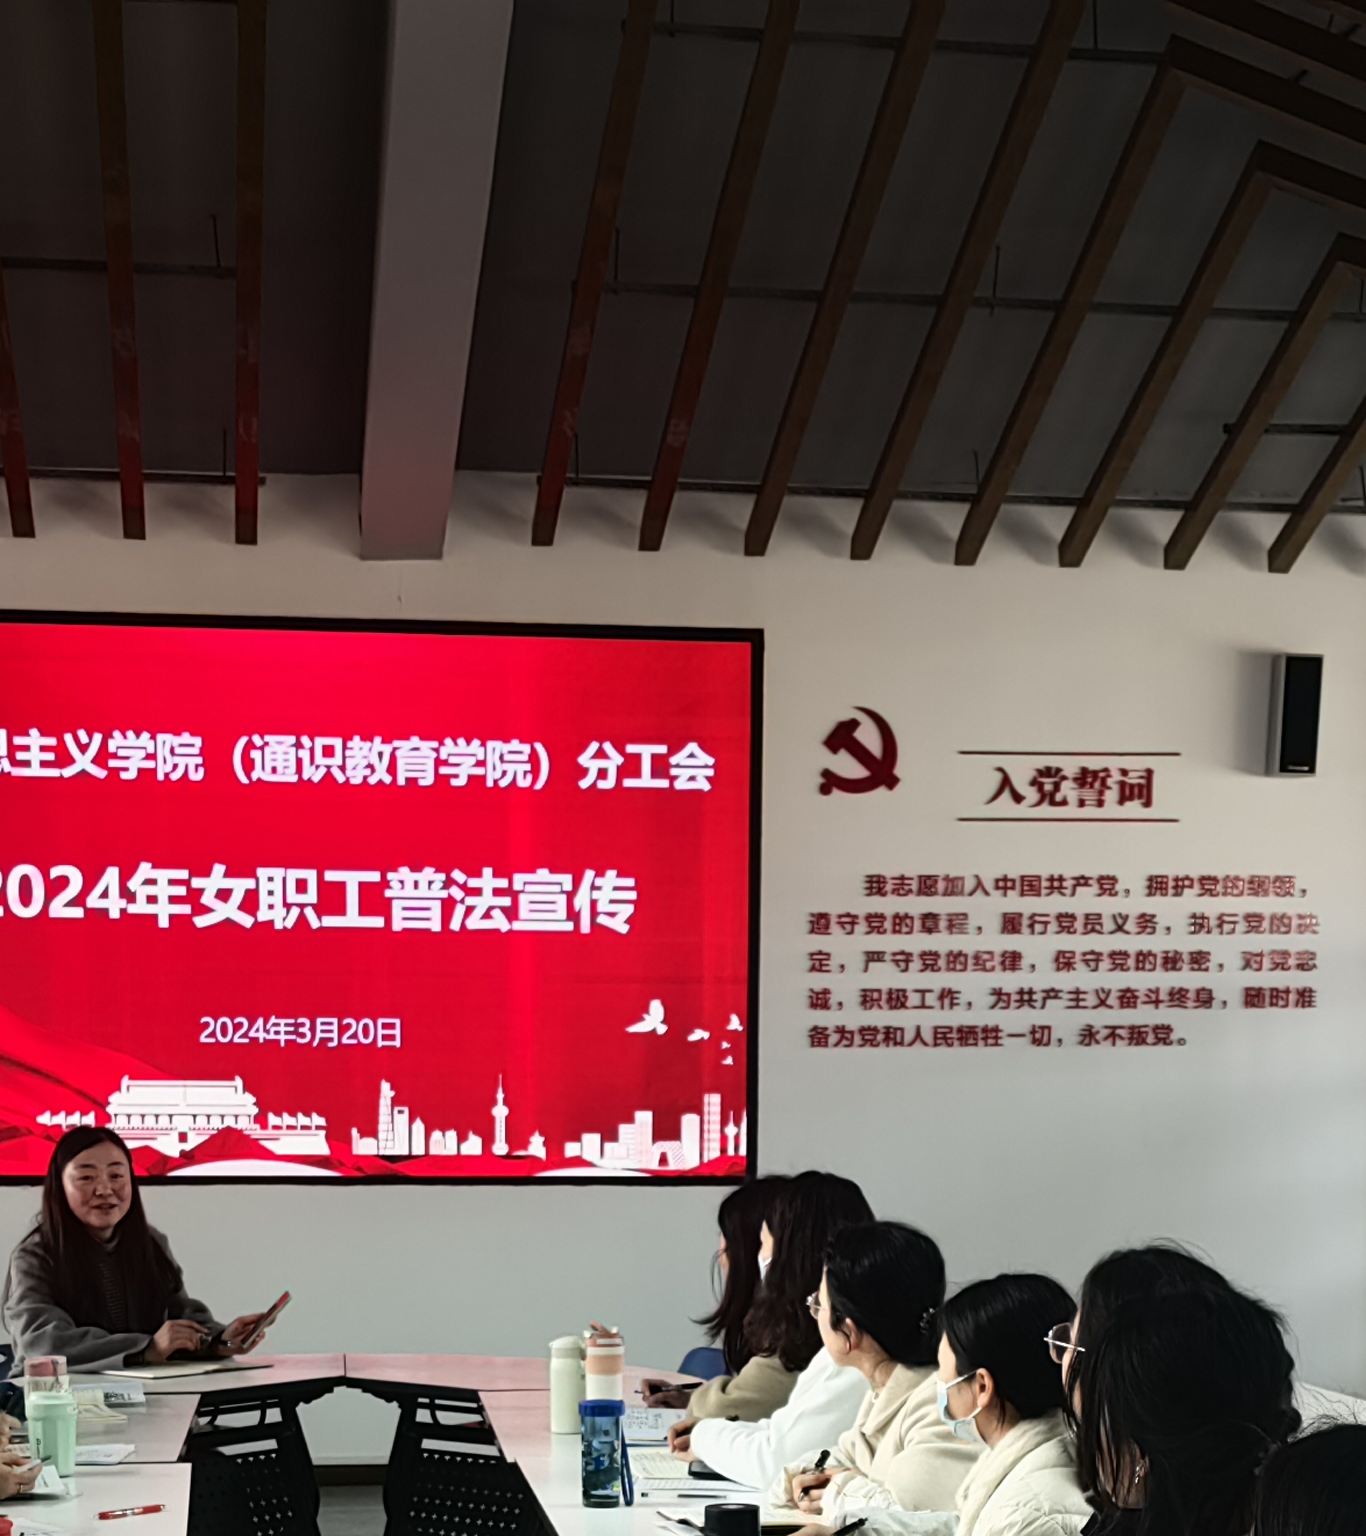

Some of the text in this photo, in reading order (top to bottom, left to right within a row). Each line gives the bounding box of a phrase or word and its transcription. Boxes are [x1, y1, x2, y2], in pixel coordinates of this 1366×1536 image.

[986, 765, 1155, 807] 入党誓词
[199, 1015, 401, 1046] 2024年3月20日
